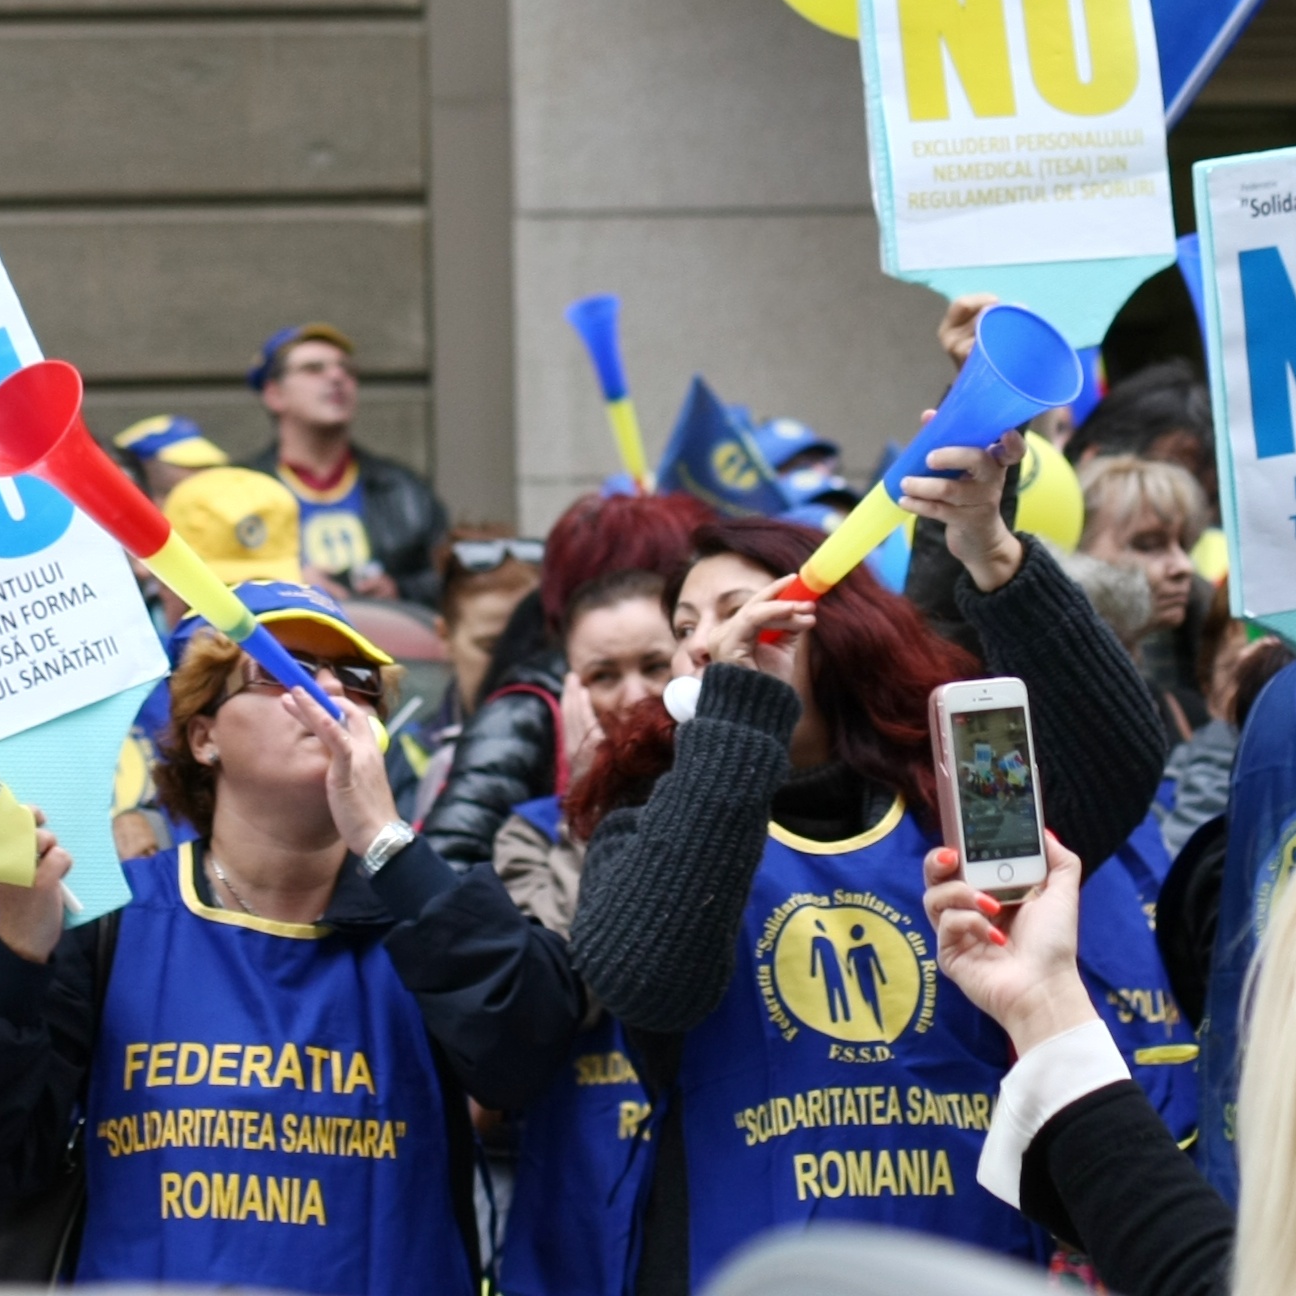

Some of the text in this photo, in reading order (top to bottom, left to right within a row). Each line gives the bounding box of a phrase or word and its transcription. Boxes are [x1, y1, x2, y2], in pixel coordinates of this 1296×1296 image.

[1097, 155, 1129, 173] DIN
[19, 581, 98, 626] FORMA
[29, 626, 61, 654] DE
[906, 930, 927, 957] din
[123, 1042, 377, 1095] FEDERATIA
[617, 1100, 652, 1141] R
[906, 1086, 1001, 1132] SANITAR
[96, 1109, 407, 1159] "SOLIDARITATEA SANITARA"
[793, 1149, 955, 1201] ROMANIA
[160, 1171, 327, 1226] ROMANIA
